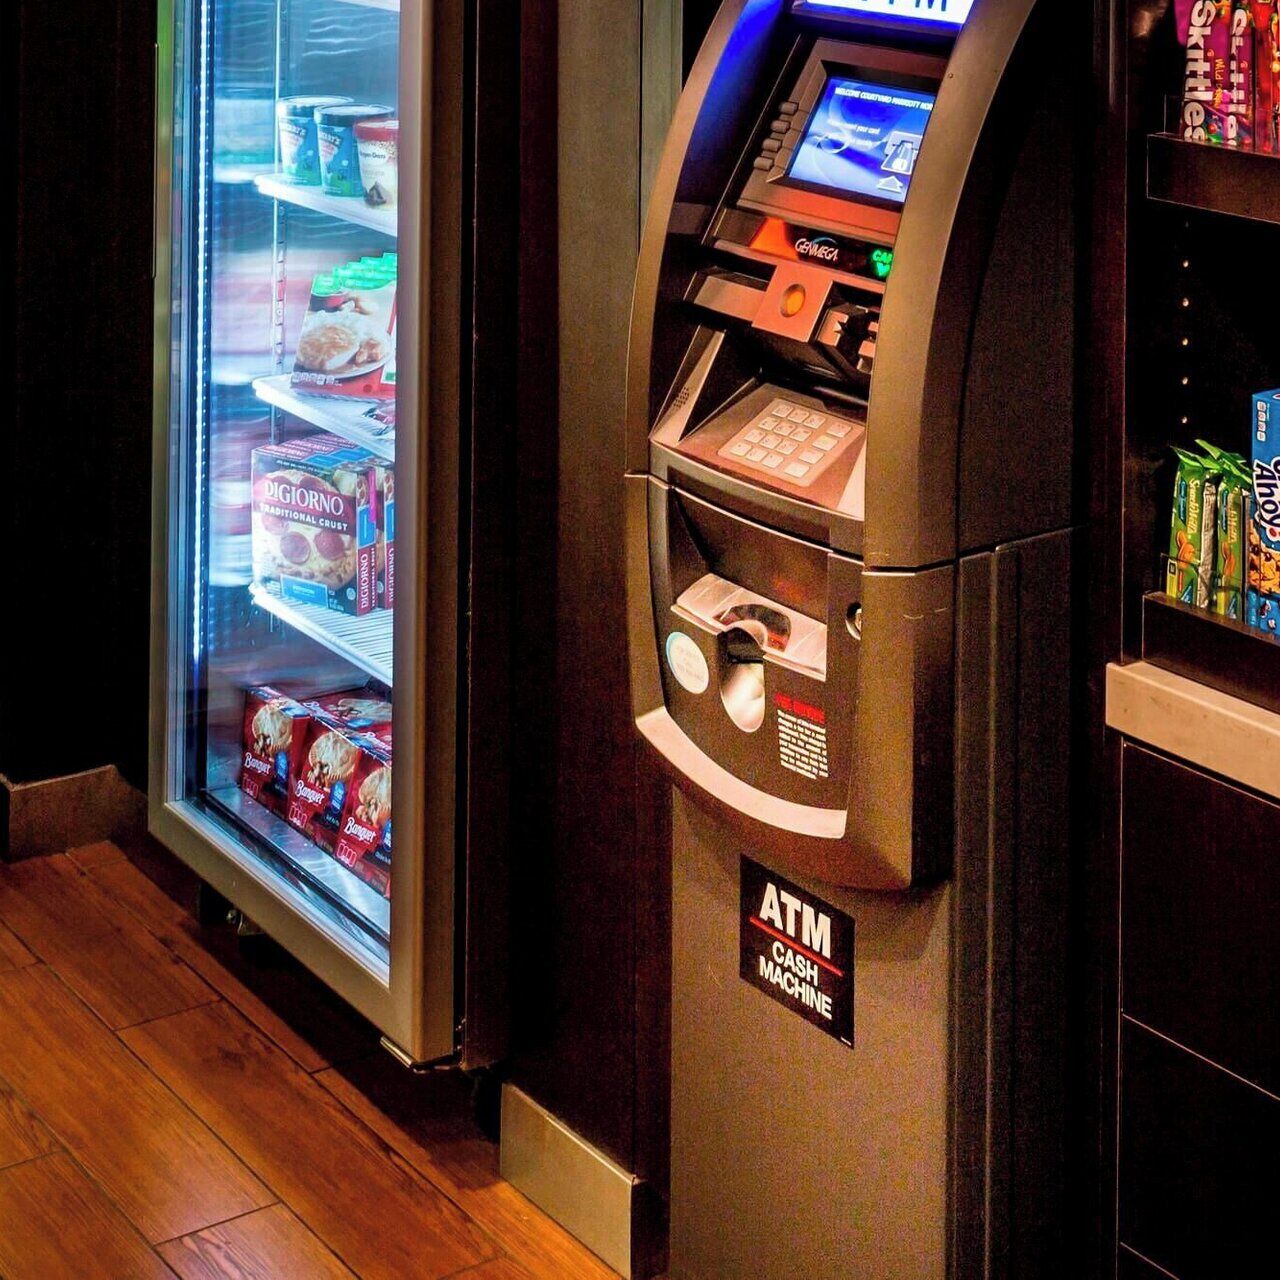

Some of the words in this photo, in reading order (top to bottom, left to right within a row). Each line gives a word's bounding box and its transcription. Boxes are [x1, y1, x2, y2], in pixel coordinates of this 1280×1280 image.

[794, 238, 839, 261] GENMEGA
[260, 503, 316, 524] TRADITIONAL
[319, 518, 348, 531] CRUST
[245, 752, 272, 775] Banquet
[297, 780, 325, 805] Banquet
[345, 816, 377, 843] Banquet
[759, 881, 832, 958] ATM
[772, 941, 819, 986] CASH
[759, 956, 833, 1021] MACHINE
